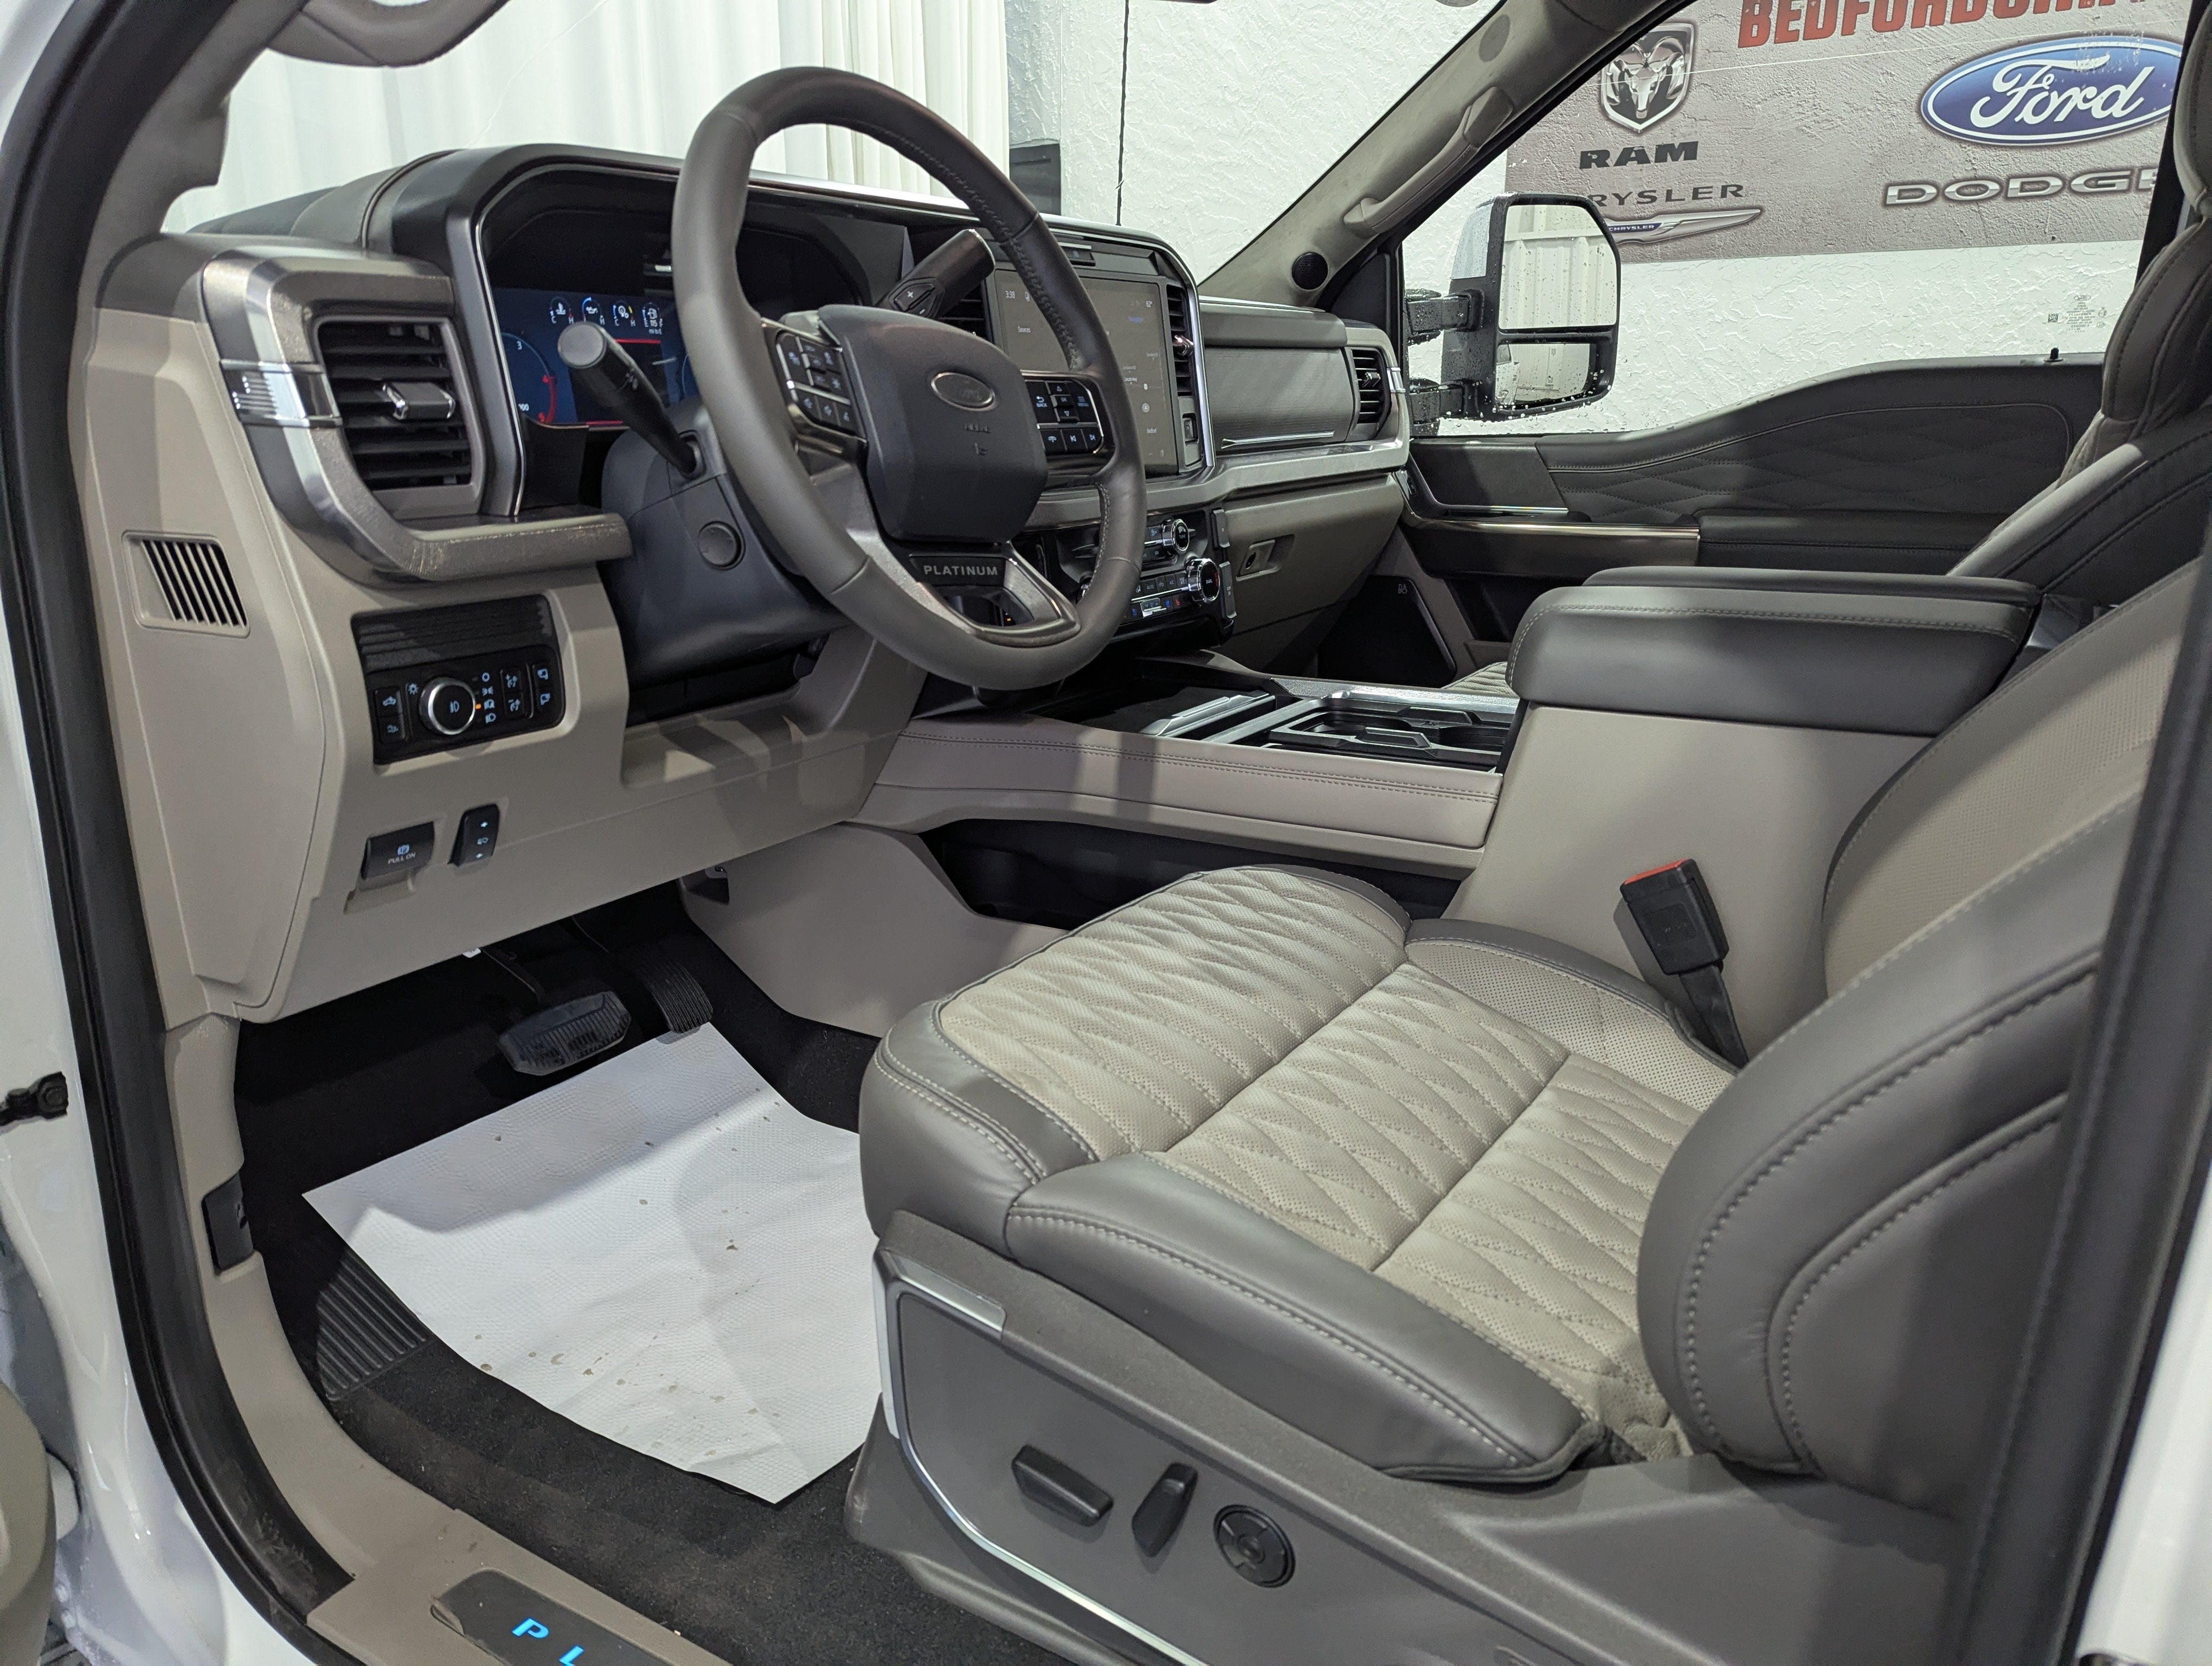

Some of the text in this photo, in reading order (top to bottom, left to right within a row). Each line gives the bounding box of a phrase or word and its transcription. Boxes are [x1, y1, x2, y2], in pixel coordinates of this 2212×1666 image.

[1970, 54, 2155, 128] Ford
[1579, 141, 1698, 170] RAM
[1589, 184, 1744, 207] RYSLER
[923, 565, 998, 575] PLATINUM
[388, 856, 404, 864] PULL
